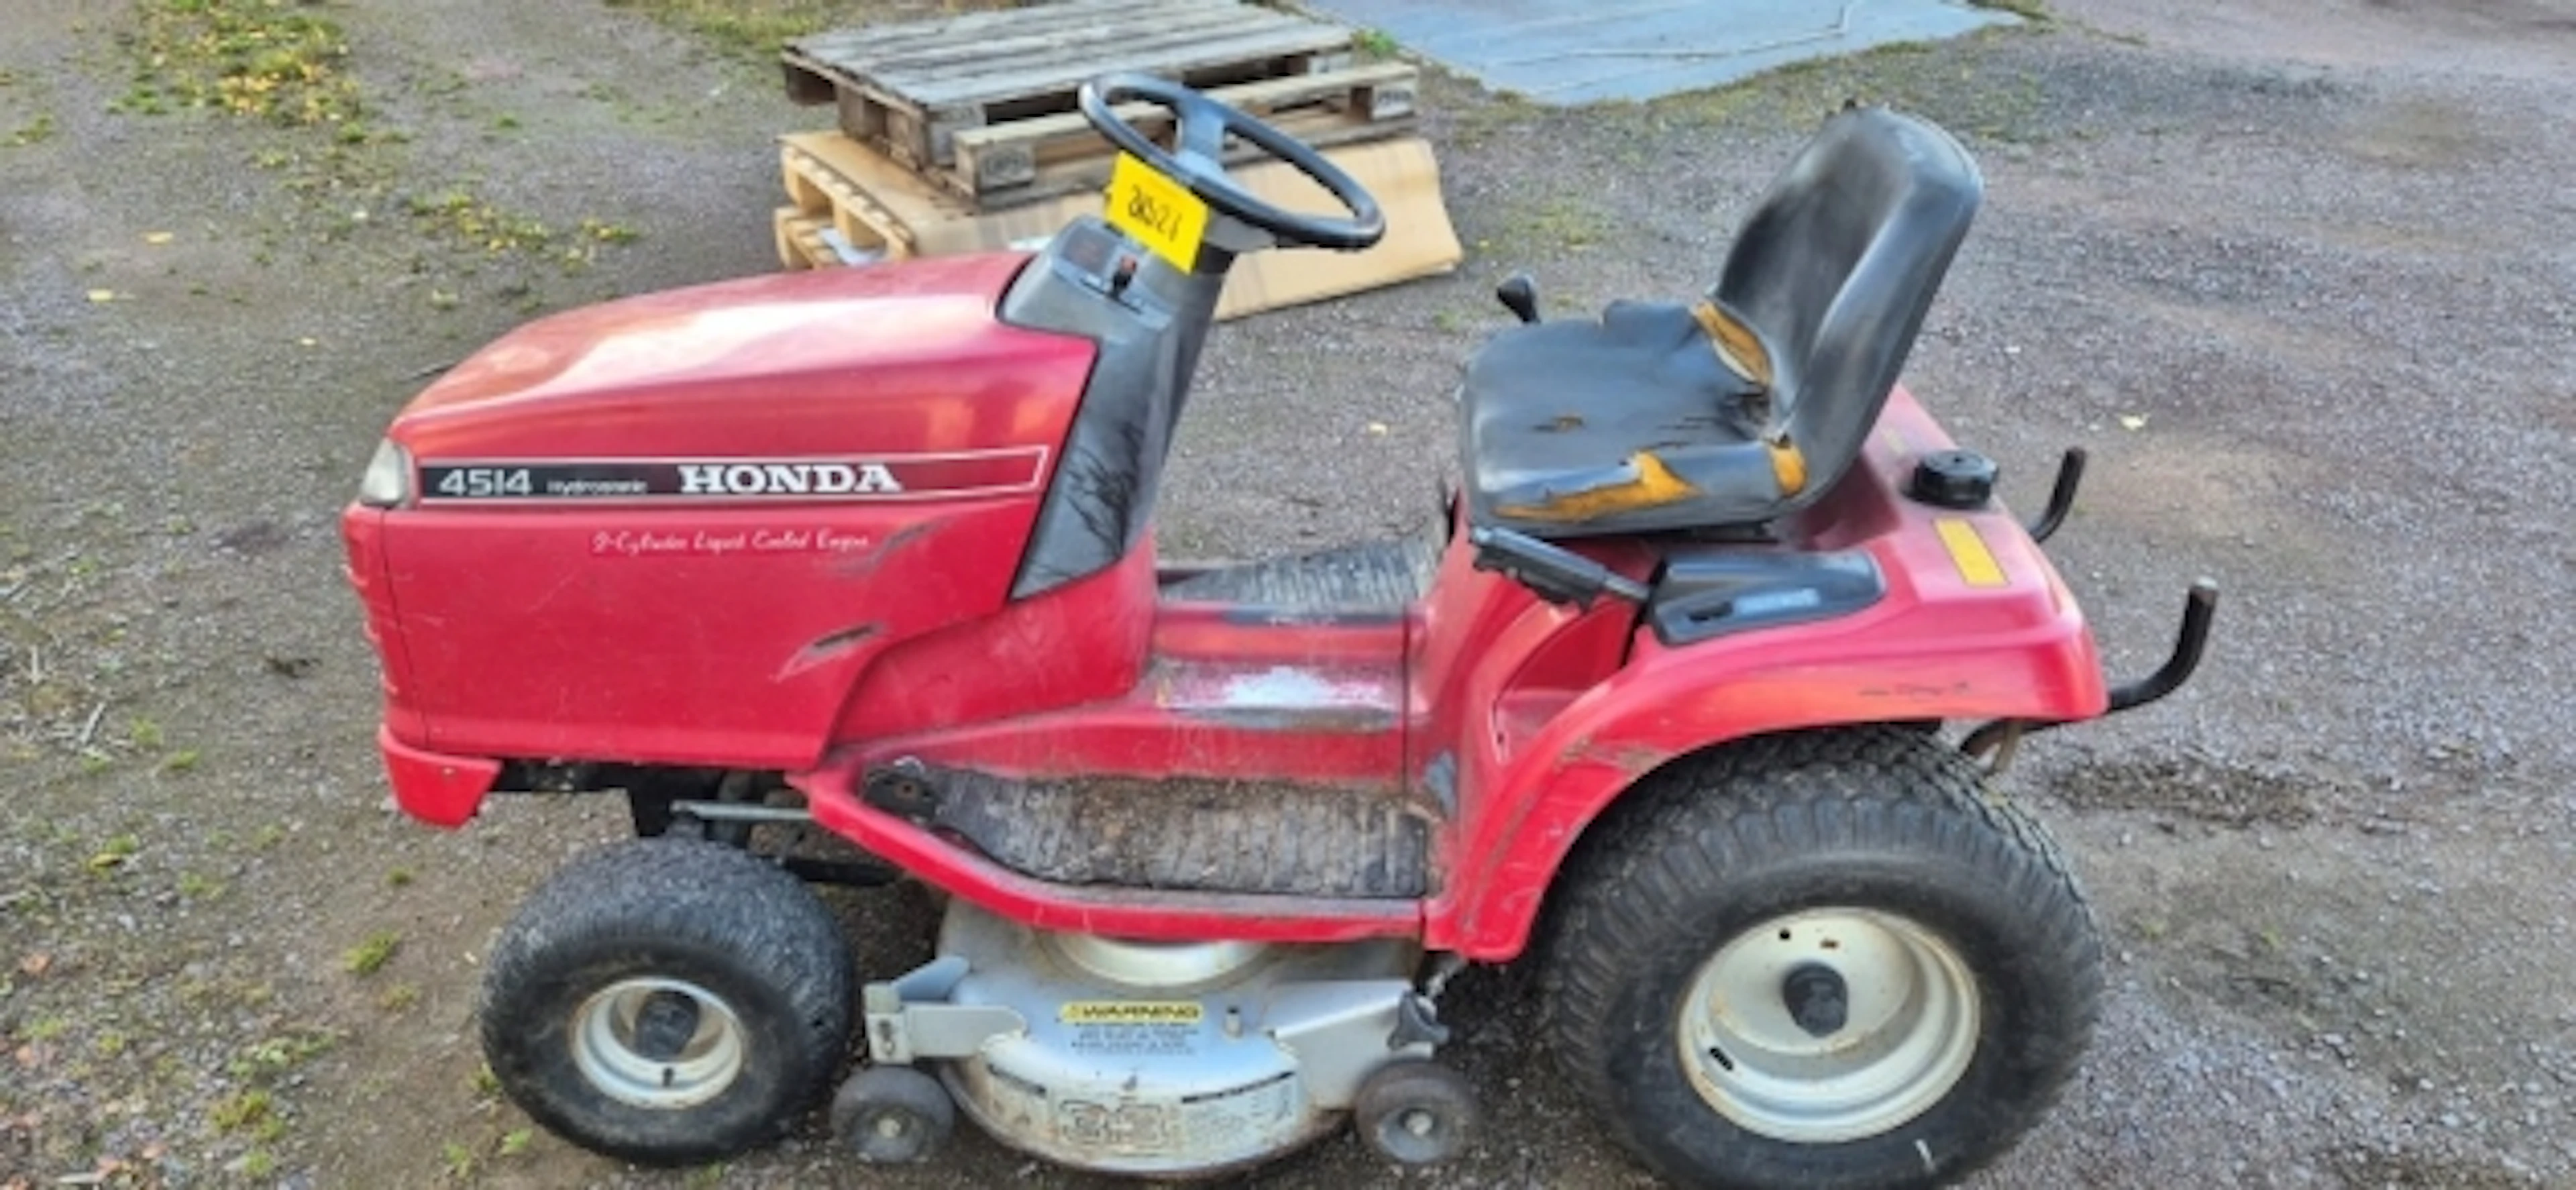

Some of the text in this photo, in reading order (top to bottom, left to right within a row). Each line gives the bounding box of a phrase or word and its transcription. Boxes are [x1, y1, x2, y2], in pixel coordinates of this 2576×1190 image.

[439, 468, 533, 496] 4514
[677, 463, 902, 494] HONDA
[1083, 1006, 1199, 1019] WARNING
